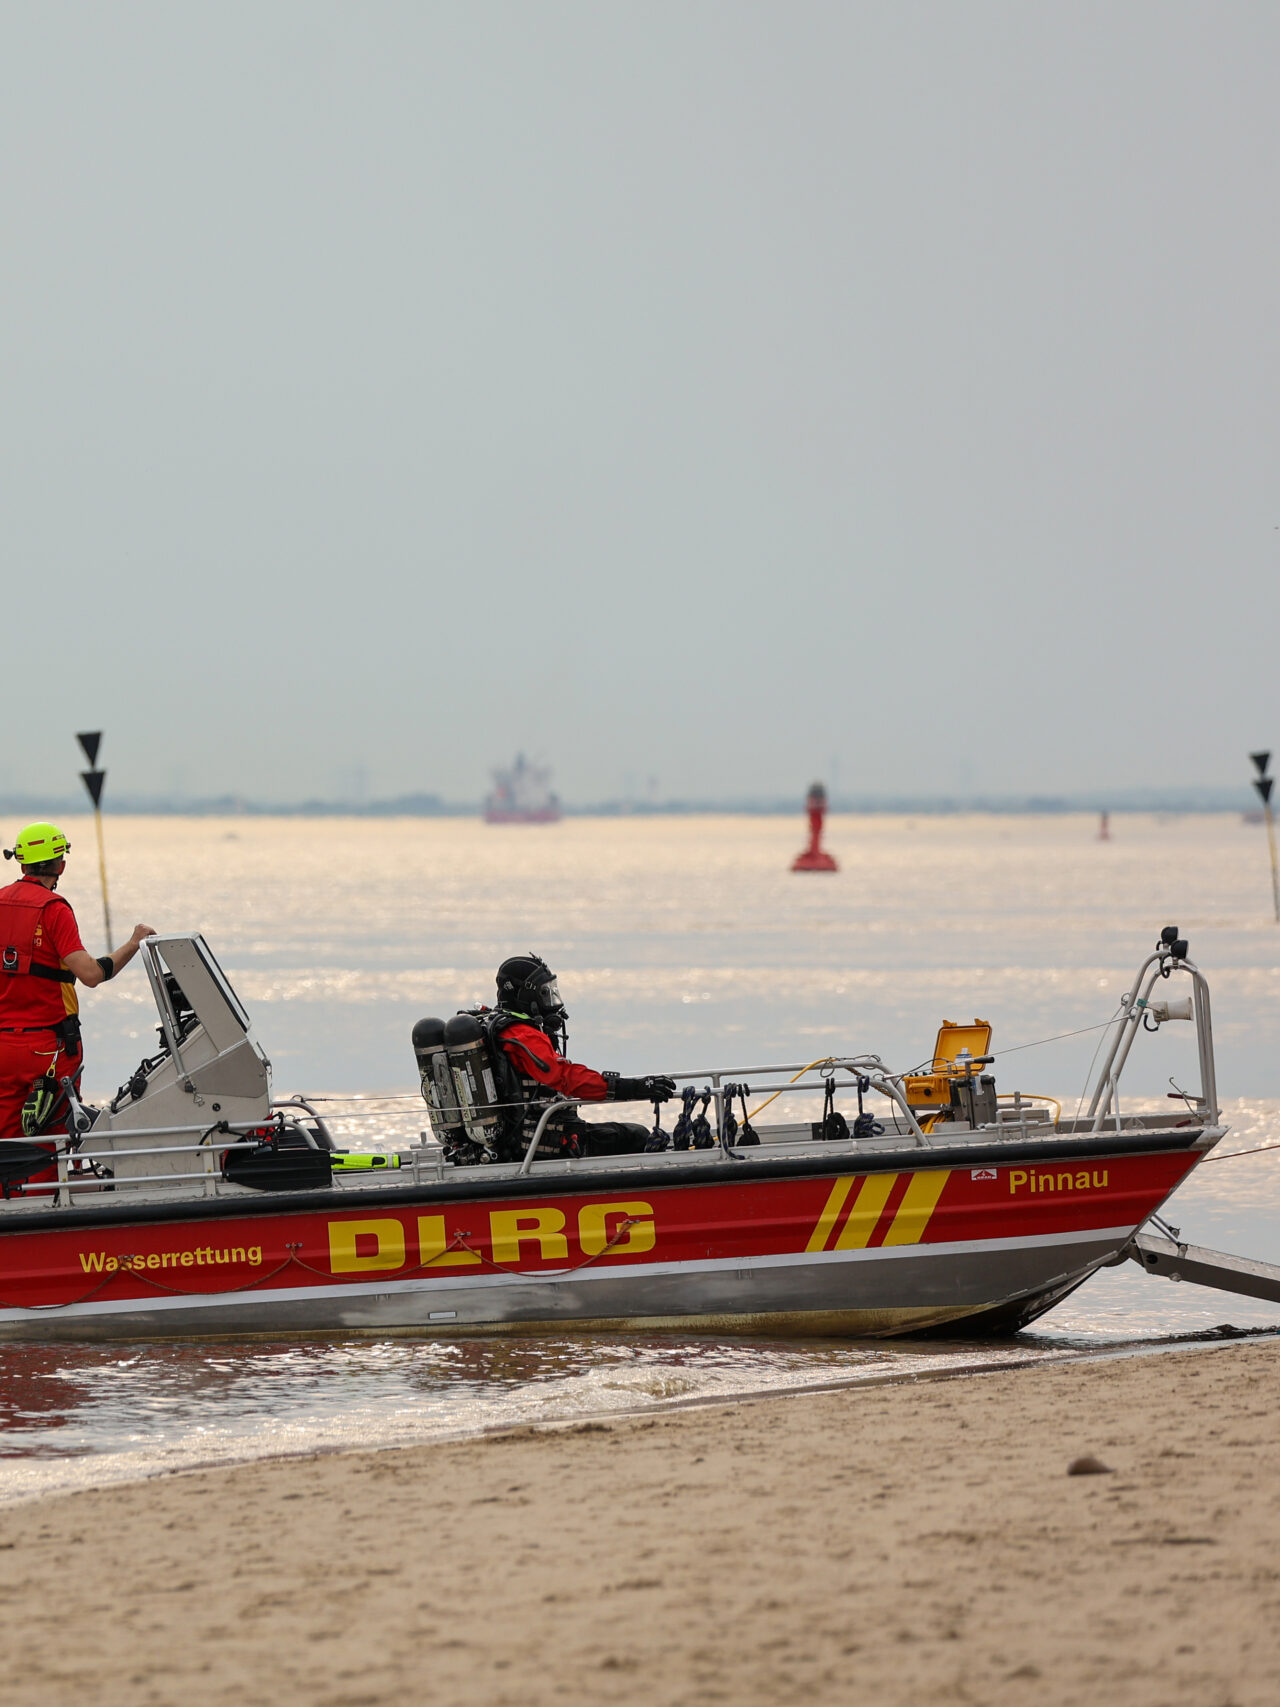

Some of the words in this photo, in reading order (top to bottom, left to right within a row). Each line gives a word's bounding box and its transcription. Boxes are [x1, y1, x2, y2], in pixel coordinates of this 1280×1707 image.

[1009, 1169, 1109, 1194] Pinnau
[328, 1201, 656, 1274] DLRG
[79, 1246, 262, 1273] Wasserrettung
